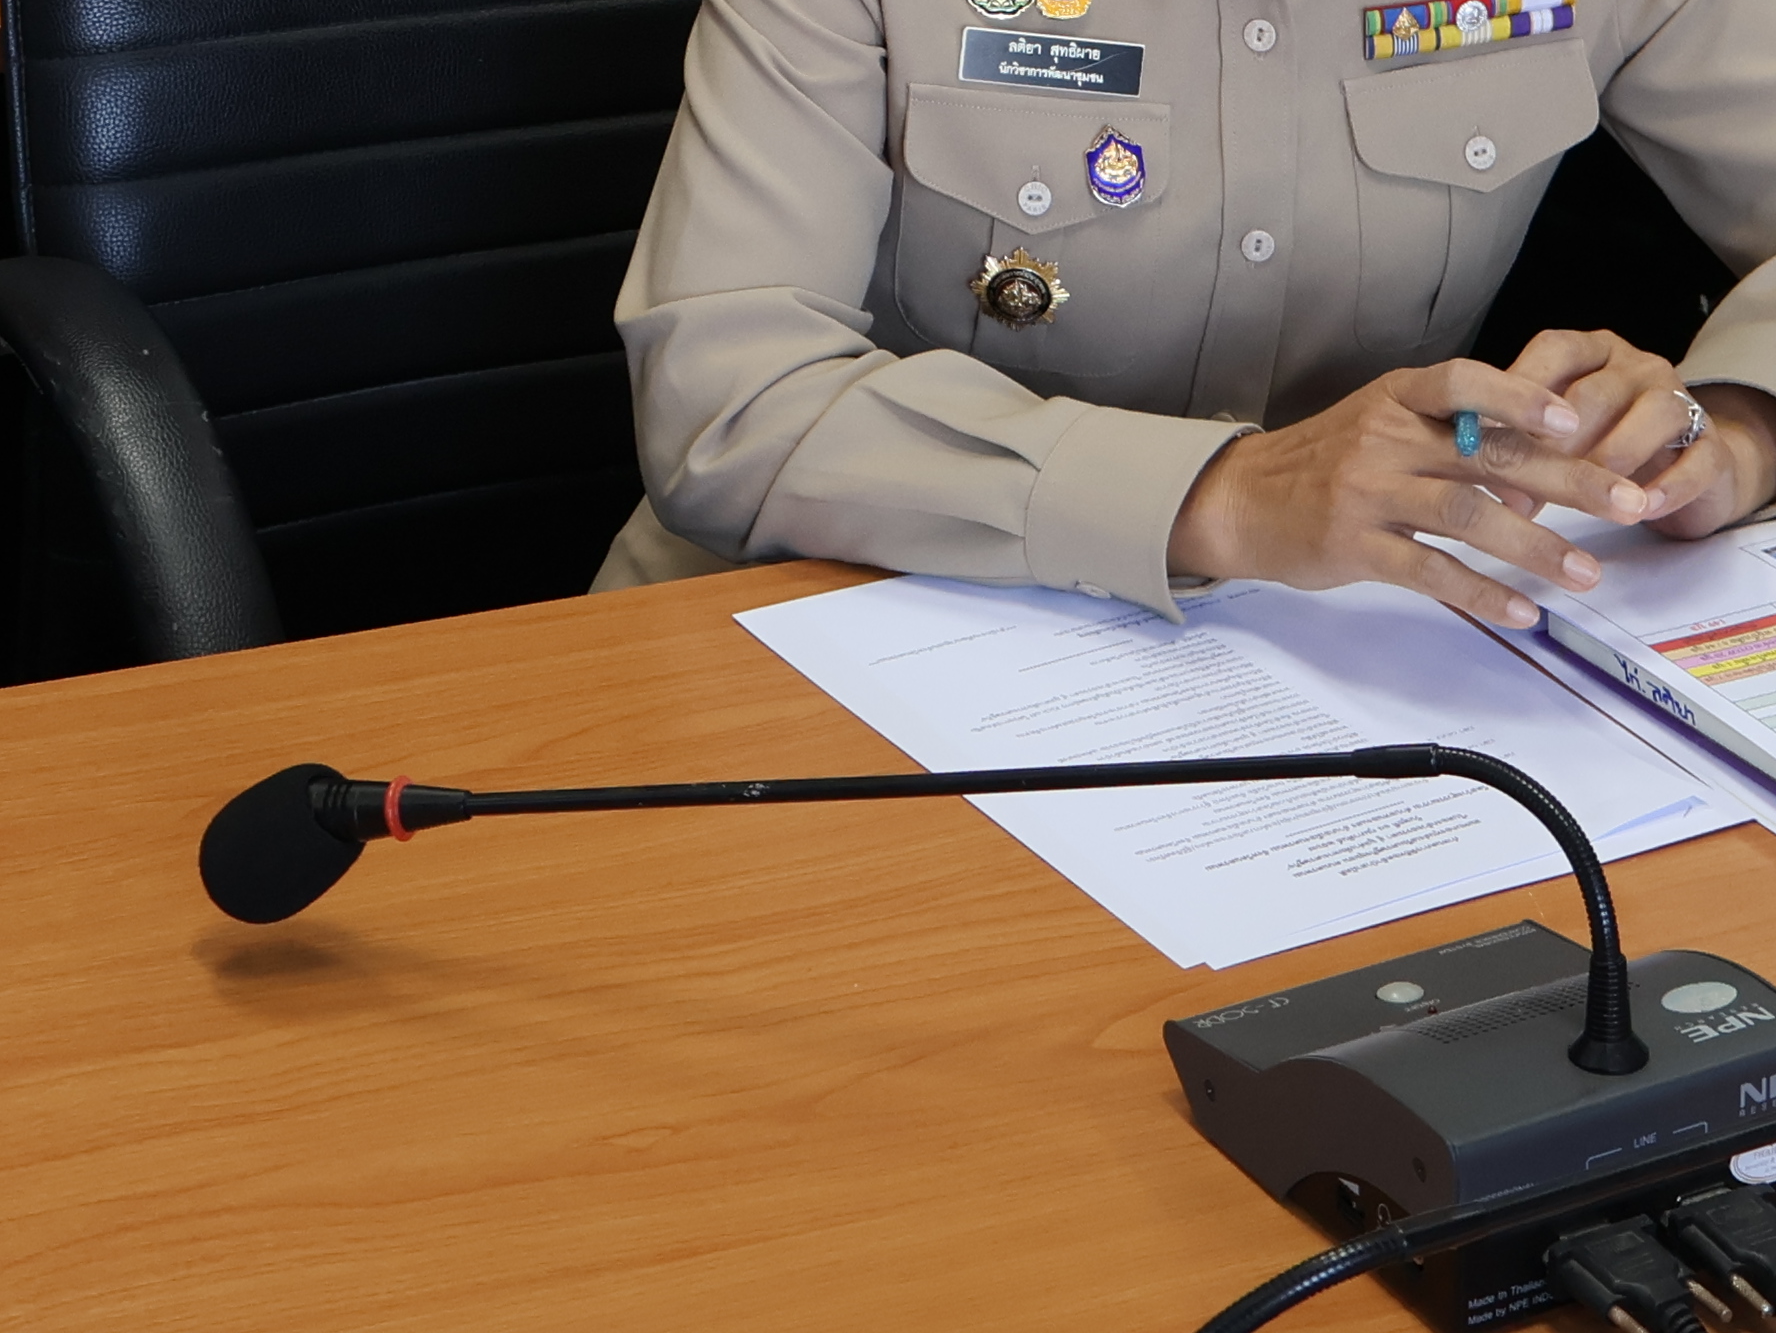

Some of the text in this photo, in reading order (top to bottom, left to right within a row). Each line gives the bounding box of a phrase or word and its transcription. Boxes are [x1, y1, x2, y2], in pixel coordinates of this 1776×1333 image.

[1681, 1005, 1776, 1043] NPE
[1633, 1131, 1658, 1149] LINE
[1468, 1292, 1496, 1310] Made
[1511, 1278, 1546, 1297] Thailan
